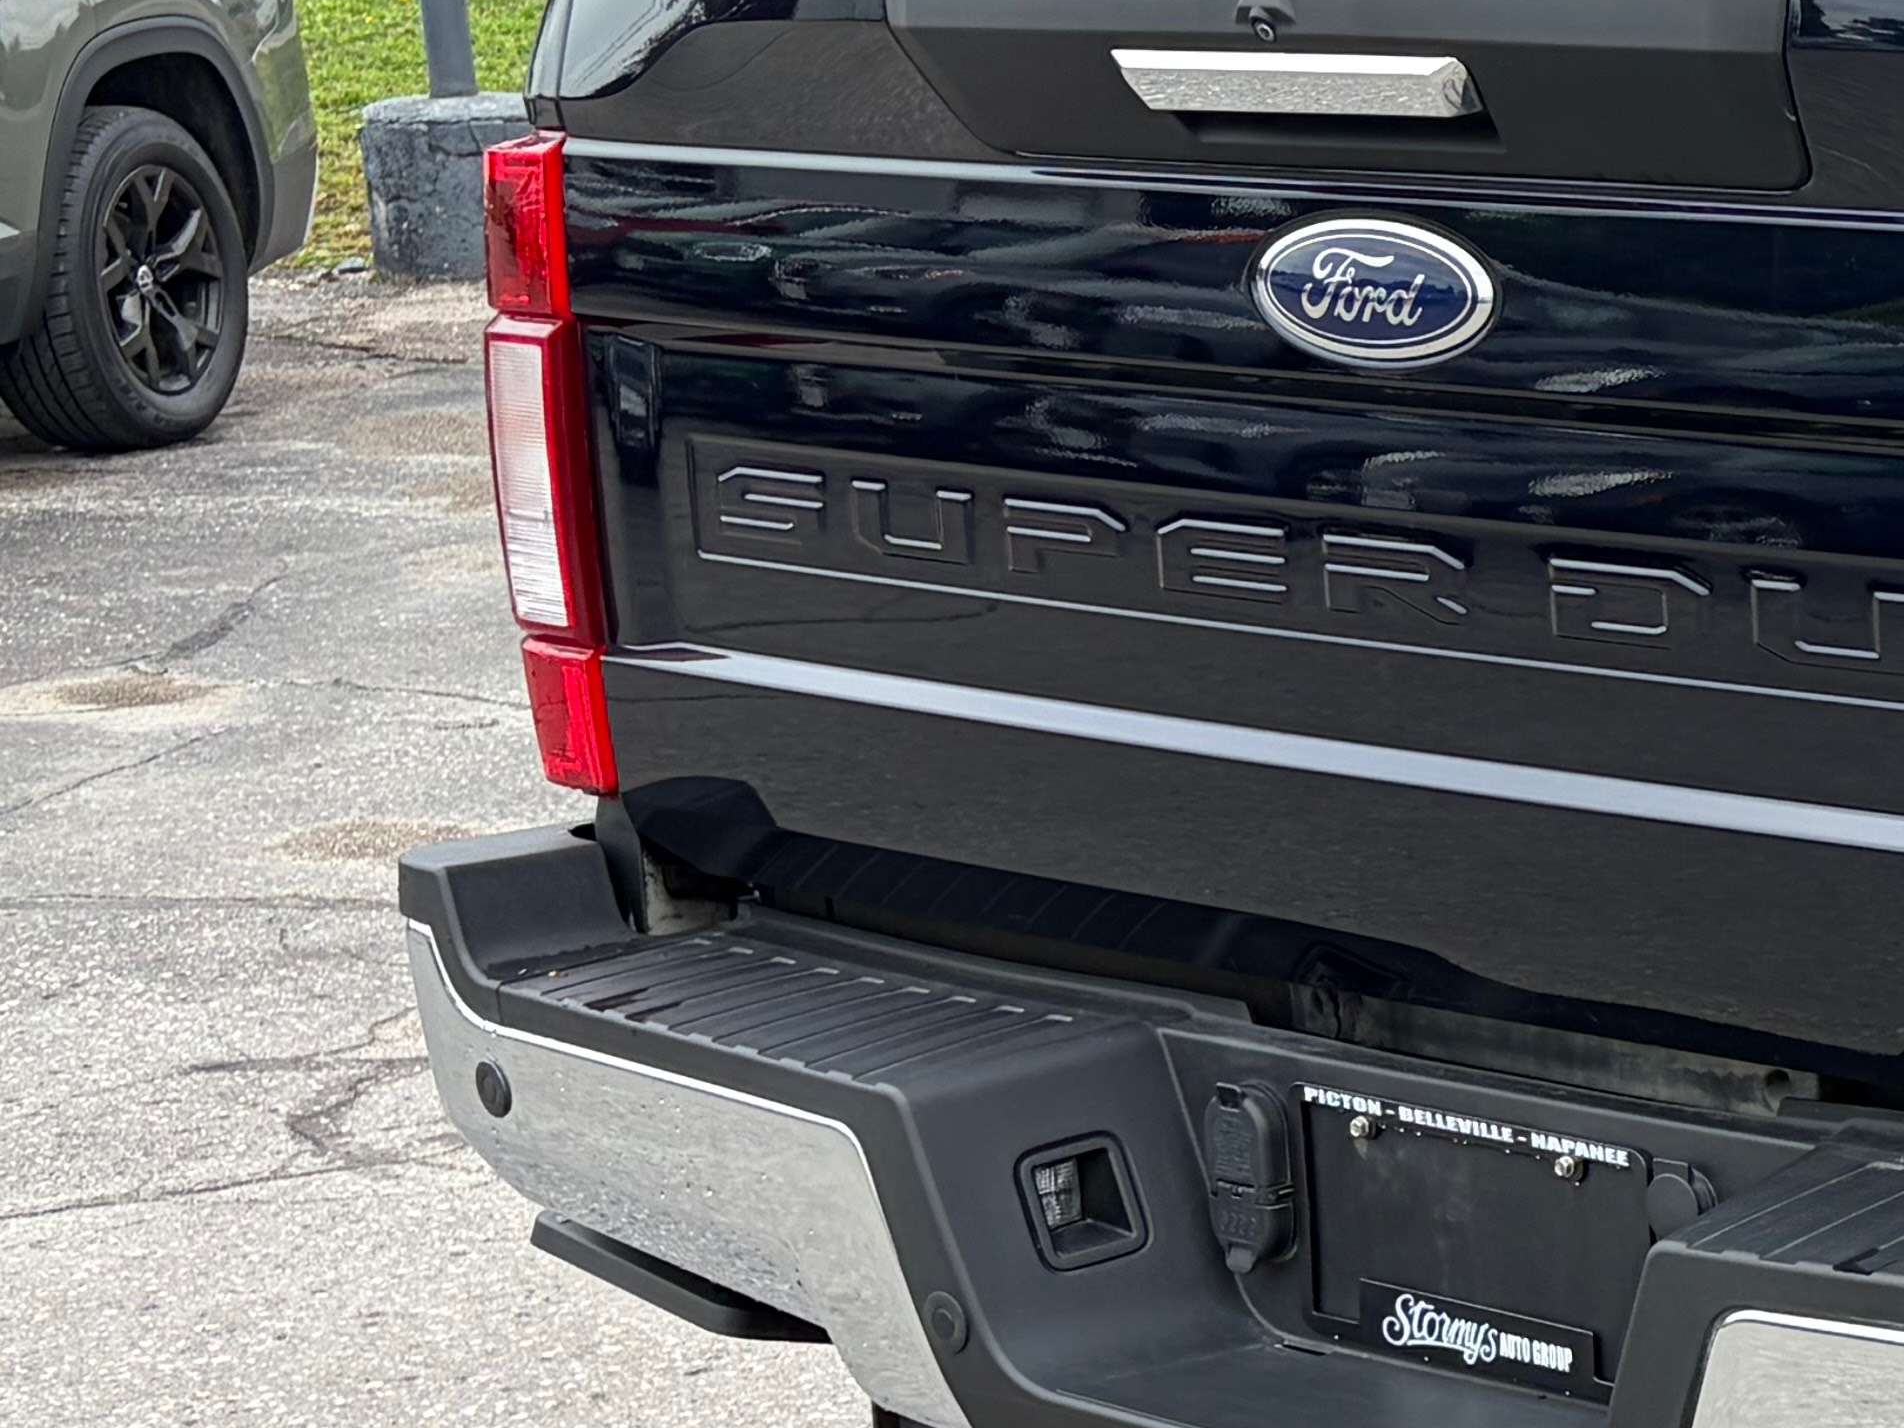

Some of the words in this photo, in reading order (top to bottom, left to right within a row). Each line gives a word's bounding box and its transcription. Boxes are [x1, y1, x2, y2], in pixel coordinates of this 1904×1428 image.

[1301, 247, 1426, 326] Ford
[717, 466, 1469, 626] SUPER
[1303, 1086, 1383, 1117] PICTON
[1398, 1105, 1515, 1144] BELLEVILLE
[1531, 1132, 1630, 1167] NAPANEE
[1499, 1332, 1530, 1363] AUTO
[1532, 1340, 1573, 1373] GROUP
